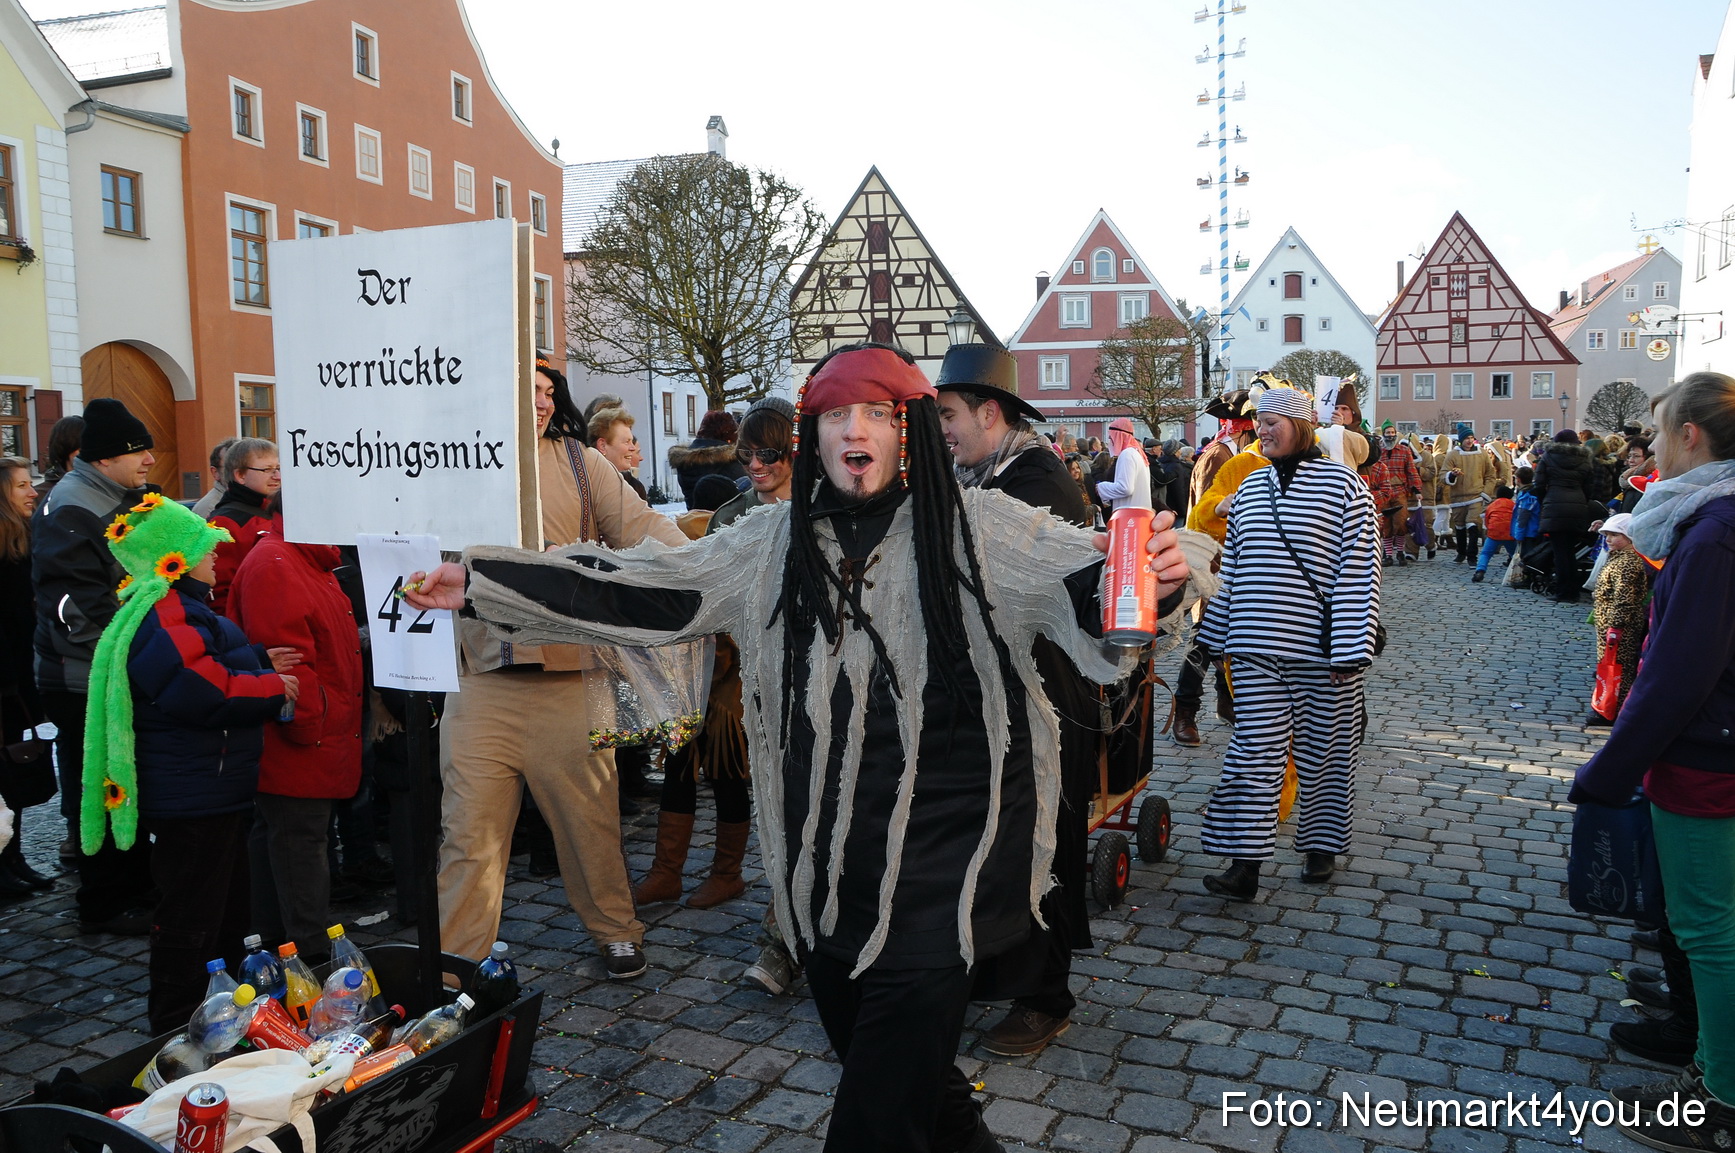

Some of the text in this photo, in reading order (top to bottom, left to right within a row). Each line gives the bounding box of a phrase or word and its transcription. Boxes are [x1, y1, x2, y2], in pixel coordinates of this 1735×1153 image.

[357, 267, 411, 307] Der
[317, 345, 463, 389] verrückte
[287, 427, 504, 478] Faschingsmix
[1586, 873, 1609, 911] Paul
